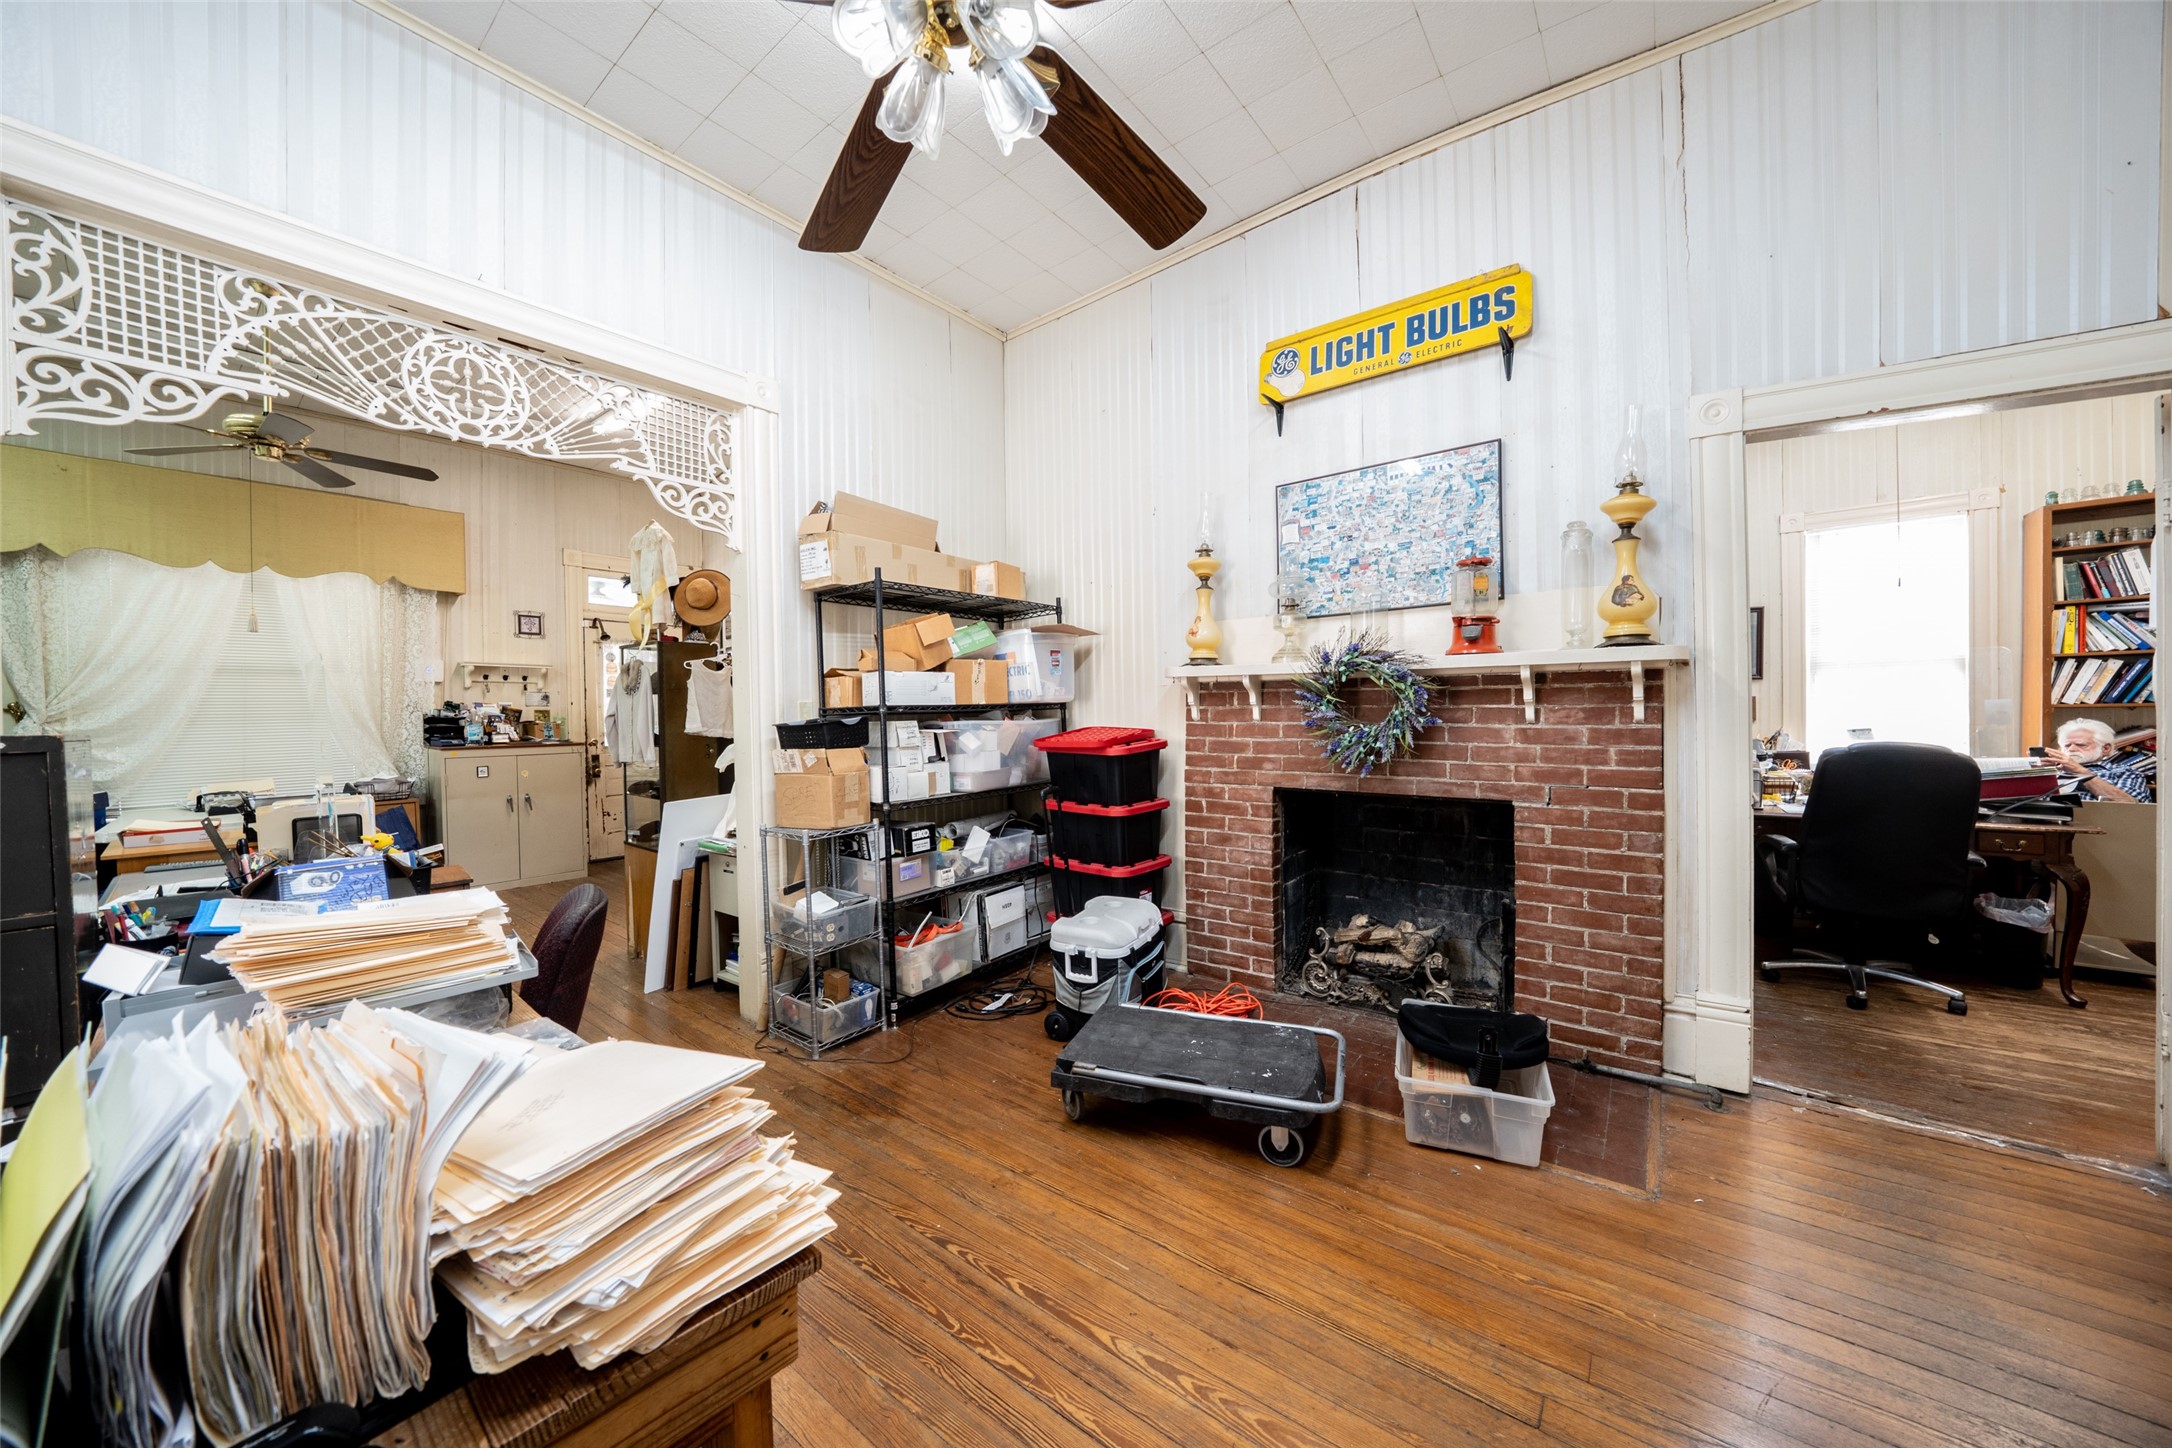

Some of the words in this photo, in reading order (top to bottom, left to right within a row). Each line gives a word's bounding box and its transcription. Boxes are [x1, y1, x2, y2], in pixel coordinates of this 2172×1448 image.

[1310, 321, 1396, 376] LIGHT
[1406, 285, 1516, 348] BULBS
[1353, 358, 1394, 376] GENERAL
[1416, 339, 1463, 359] ELECTRIC
[1007, 663, 1031, 678] CTRIC
